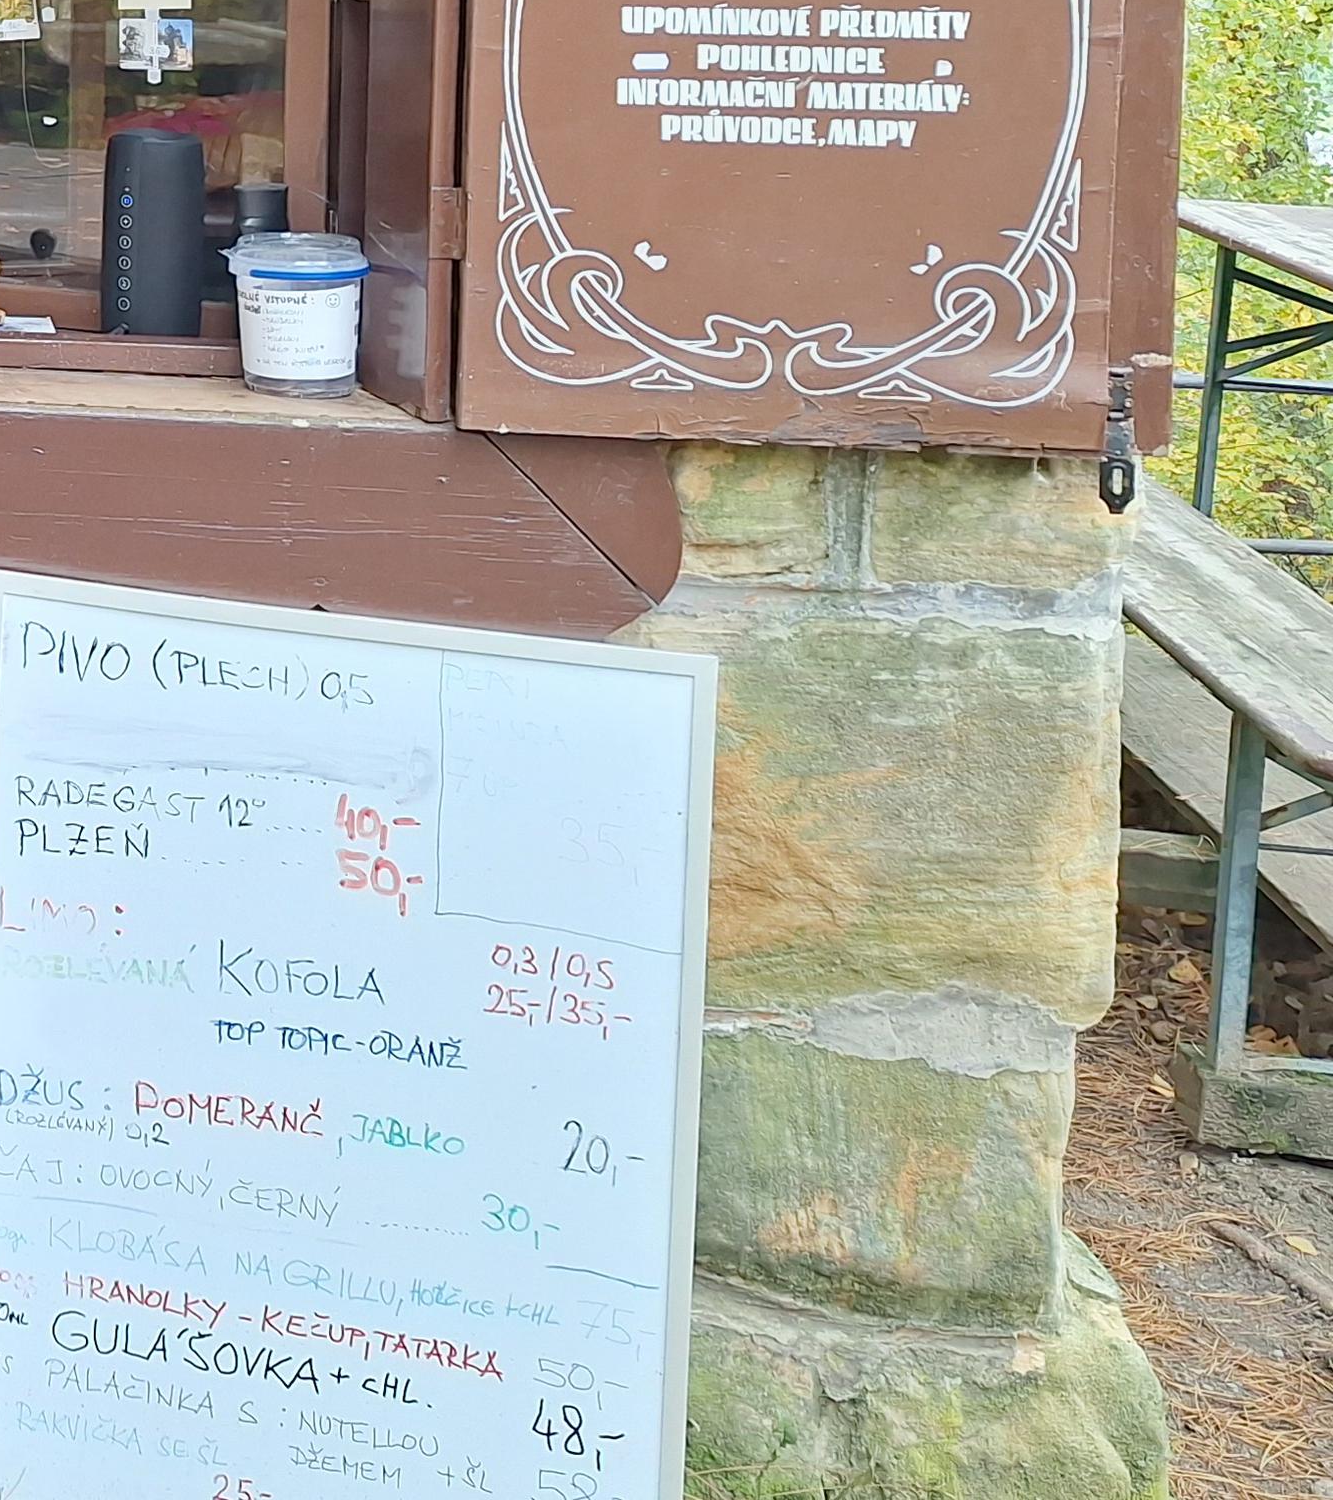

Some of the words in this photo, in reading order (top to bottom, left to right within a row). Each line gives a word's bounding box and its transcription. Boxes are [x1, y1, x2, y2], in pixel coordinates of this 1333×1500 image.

[620, 3, 814, 37] UPOMÍNKOVÉ
[819, 4, 971, 40] PŘEDMĚTY
[696, 43, 886, 74] POHLEDNICE
[616, 76, 801, 109] INFORMAČNÍ
[806, 80, 970, 112] MATERIÁLY:
[21, 619, 130, 682] PIVO
[152, 638, 311, 702] (PLECH)
[14, 774, 205, 819] RADEGAST
[334, 792, 422, 851] 40,-
[17, 817, 152, 861] PLZEŇ
[337, 849, 425, 917] 50,-
[216, 939, 386, 1004] KOFOLA
[214, 1019, 266, 1046] TOP
[562, 1120, 645, 1177] 20,-
[48, 1216, 208, 1276] KLOBÁSA
[234, 1252, 272, 1285] NA
[481, 1192, 561, 1251] 30,-
[64, 1270, 227, 1329] HRANOLKY
[44, 1358, 214, 1418] PALAČINKA
[298, 1409, 439, 1458] NUTELLOU
[52, 1310, 320, 1395] GULÁŠOVKA
[533, 1399, 626, 1471] 48,-
[289, 1441, 401, 1489] DŽEMEM
